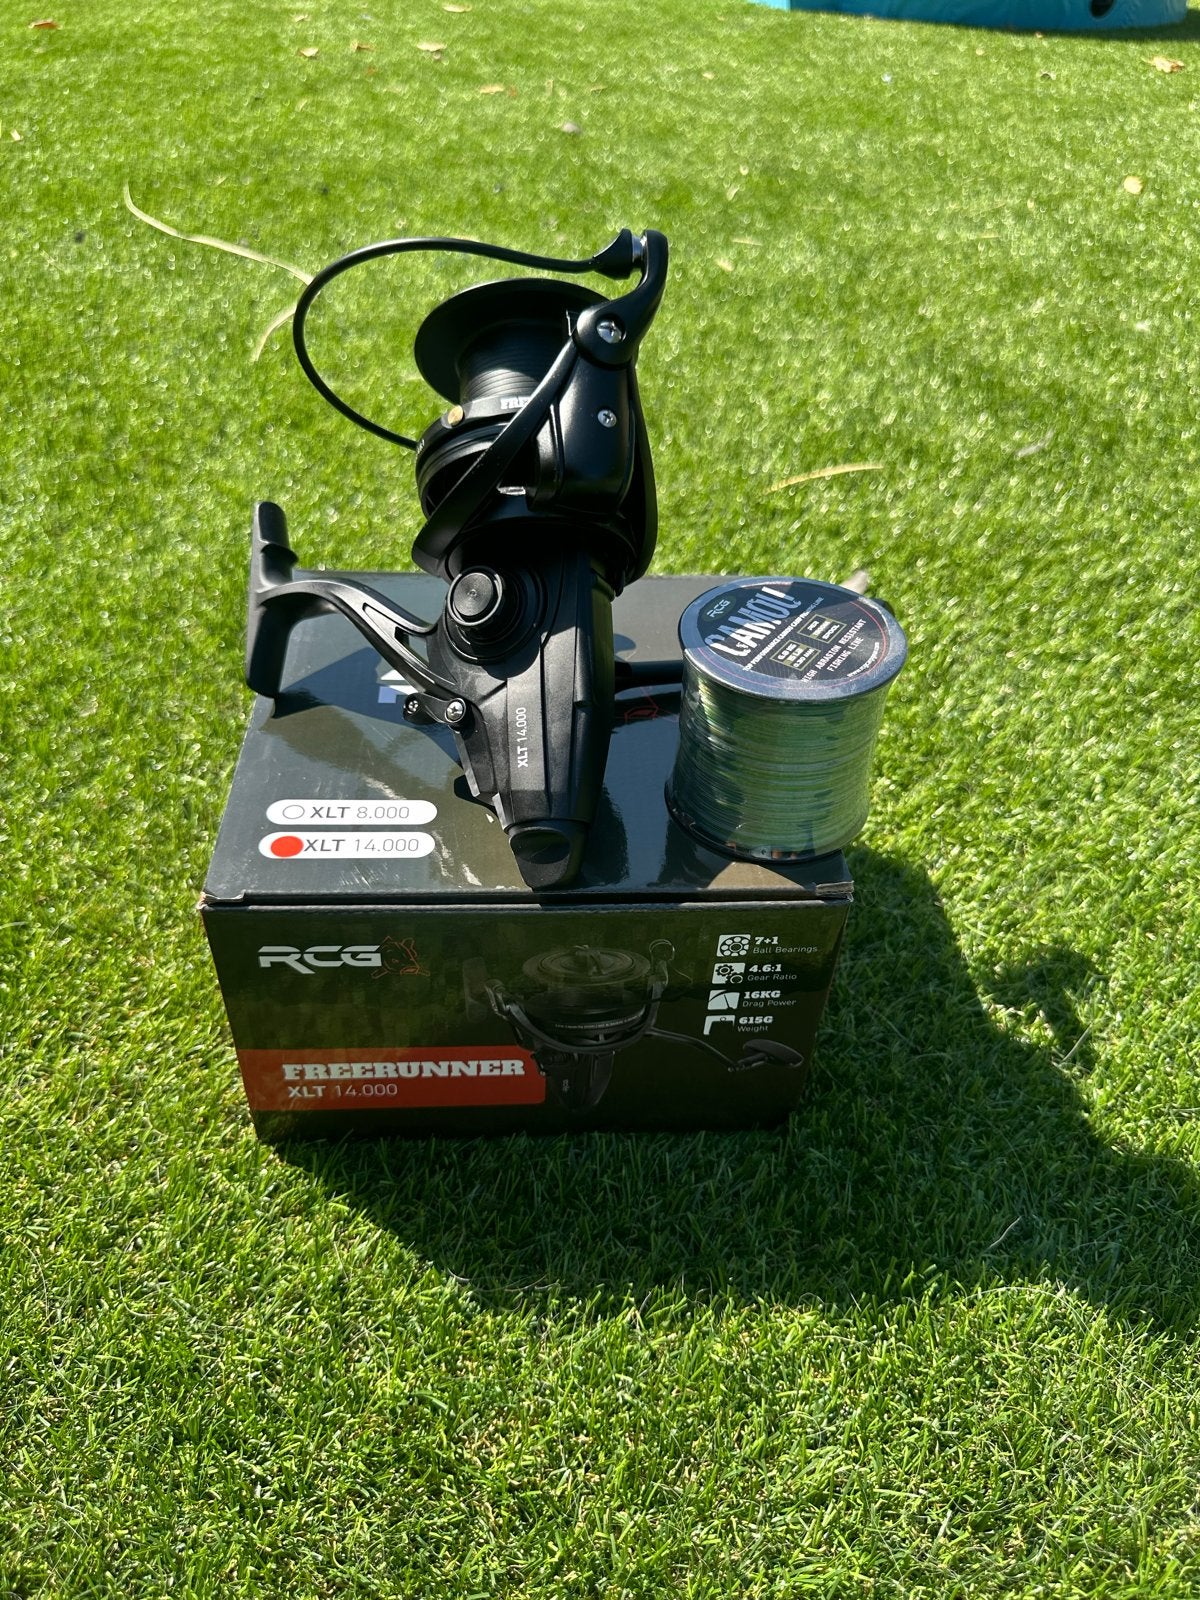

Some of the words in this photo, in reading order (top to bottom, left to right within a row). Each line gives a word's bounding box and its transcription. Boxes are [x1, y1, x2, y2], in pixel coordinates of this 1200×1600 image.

[706, 599, 731, 618] RCG
[801, 669, 818, 683] HIGH
[815, 645, 842, 670] ABRASION
[838, 618, 867, 645] RESISTANT
[826, 650, 852, 672] FISHING
[847, 636, 864, 650] LINE
[517, 706, 527, 743] 14.000
[517, 746, 528, 768] XLT
[309, 806, 350, 819] XLT
[355, 806, 410, 819] 8.000
[303, 838, 346, 852] XLT
[354, 838, 419, 852] 14.000
[755, 936, 779, 945] 7+1
[753, 946, 772, 954] Ball
[775, 945, 818, 954] Bearings
[258, 945, 382, 975] RCG
[748, 964, 782, 972] 4.6:1
[744, 990, 781, 999] 16KG
[739, 1016, 774, 1024] 615G
[737, 1025, 769, 1033] Weight
[282, 1059, 525, 1081] FREERUNNER
[288, 1085, 326, 1098] XLT
[335, 1083, 398, 1098] 14.000
